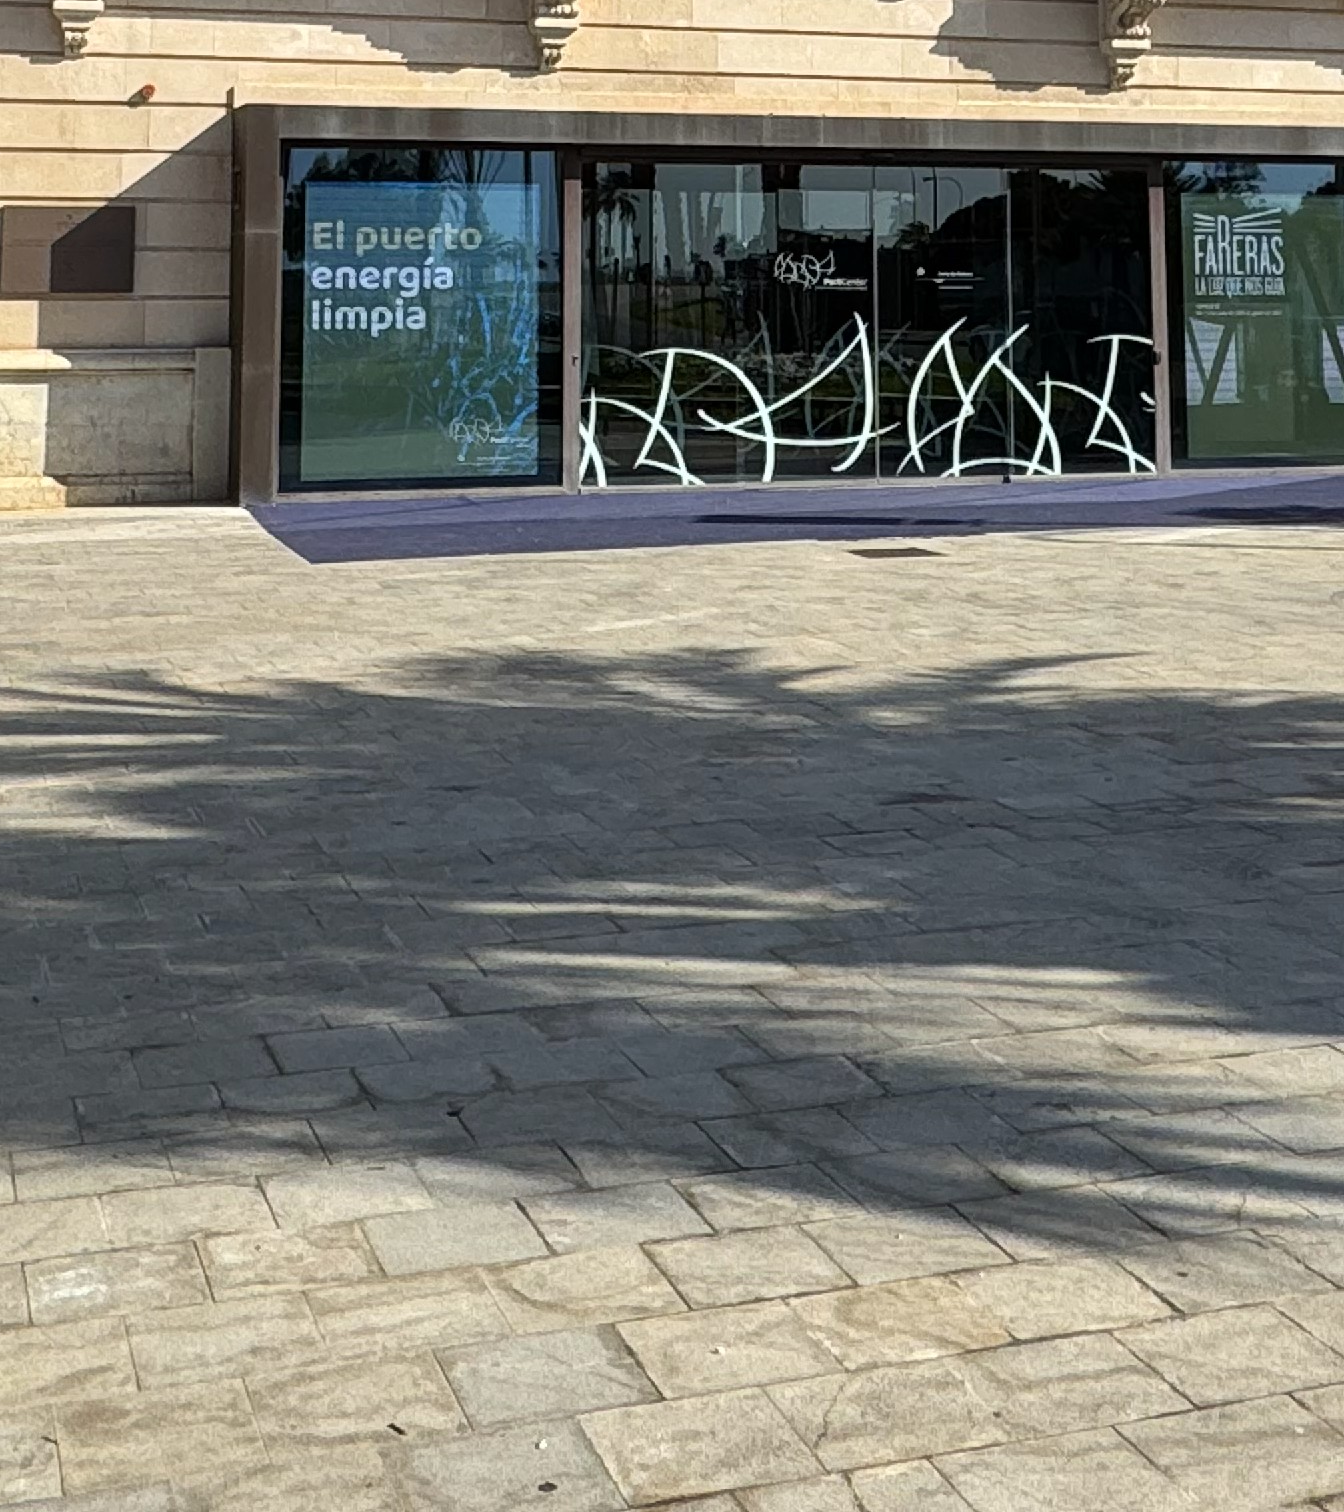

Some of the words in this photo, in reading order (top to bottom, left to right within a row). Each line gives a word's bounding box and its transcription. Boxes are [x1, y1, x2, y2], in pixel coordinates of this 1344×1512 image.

[313, 219, 344, 250] El
[356, 222, 482, 257] puerto
[1194, 215, 1285, 275] FARERAS
[311, 256, 454, 298] energía
[312, 298, 426, 338] limpia
